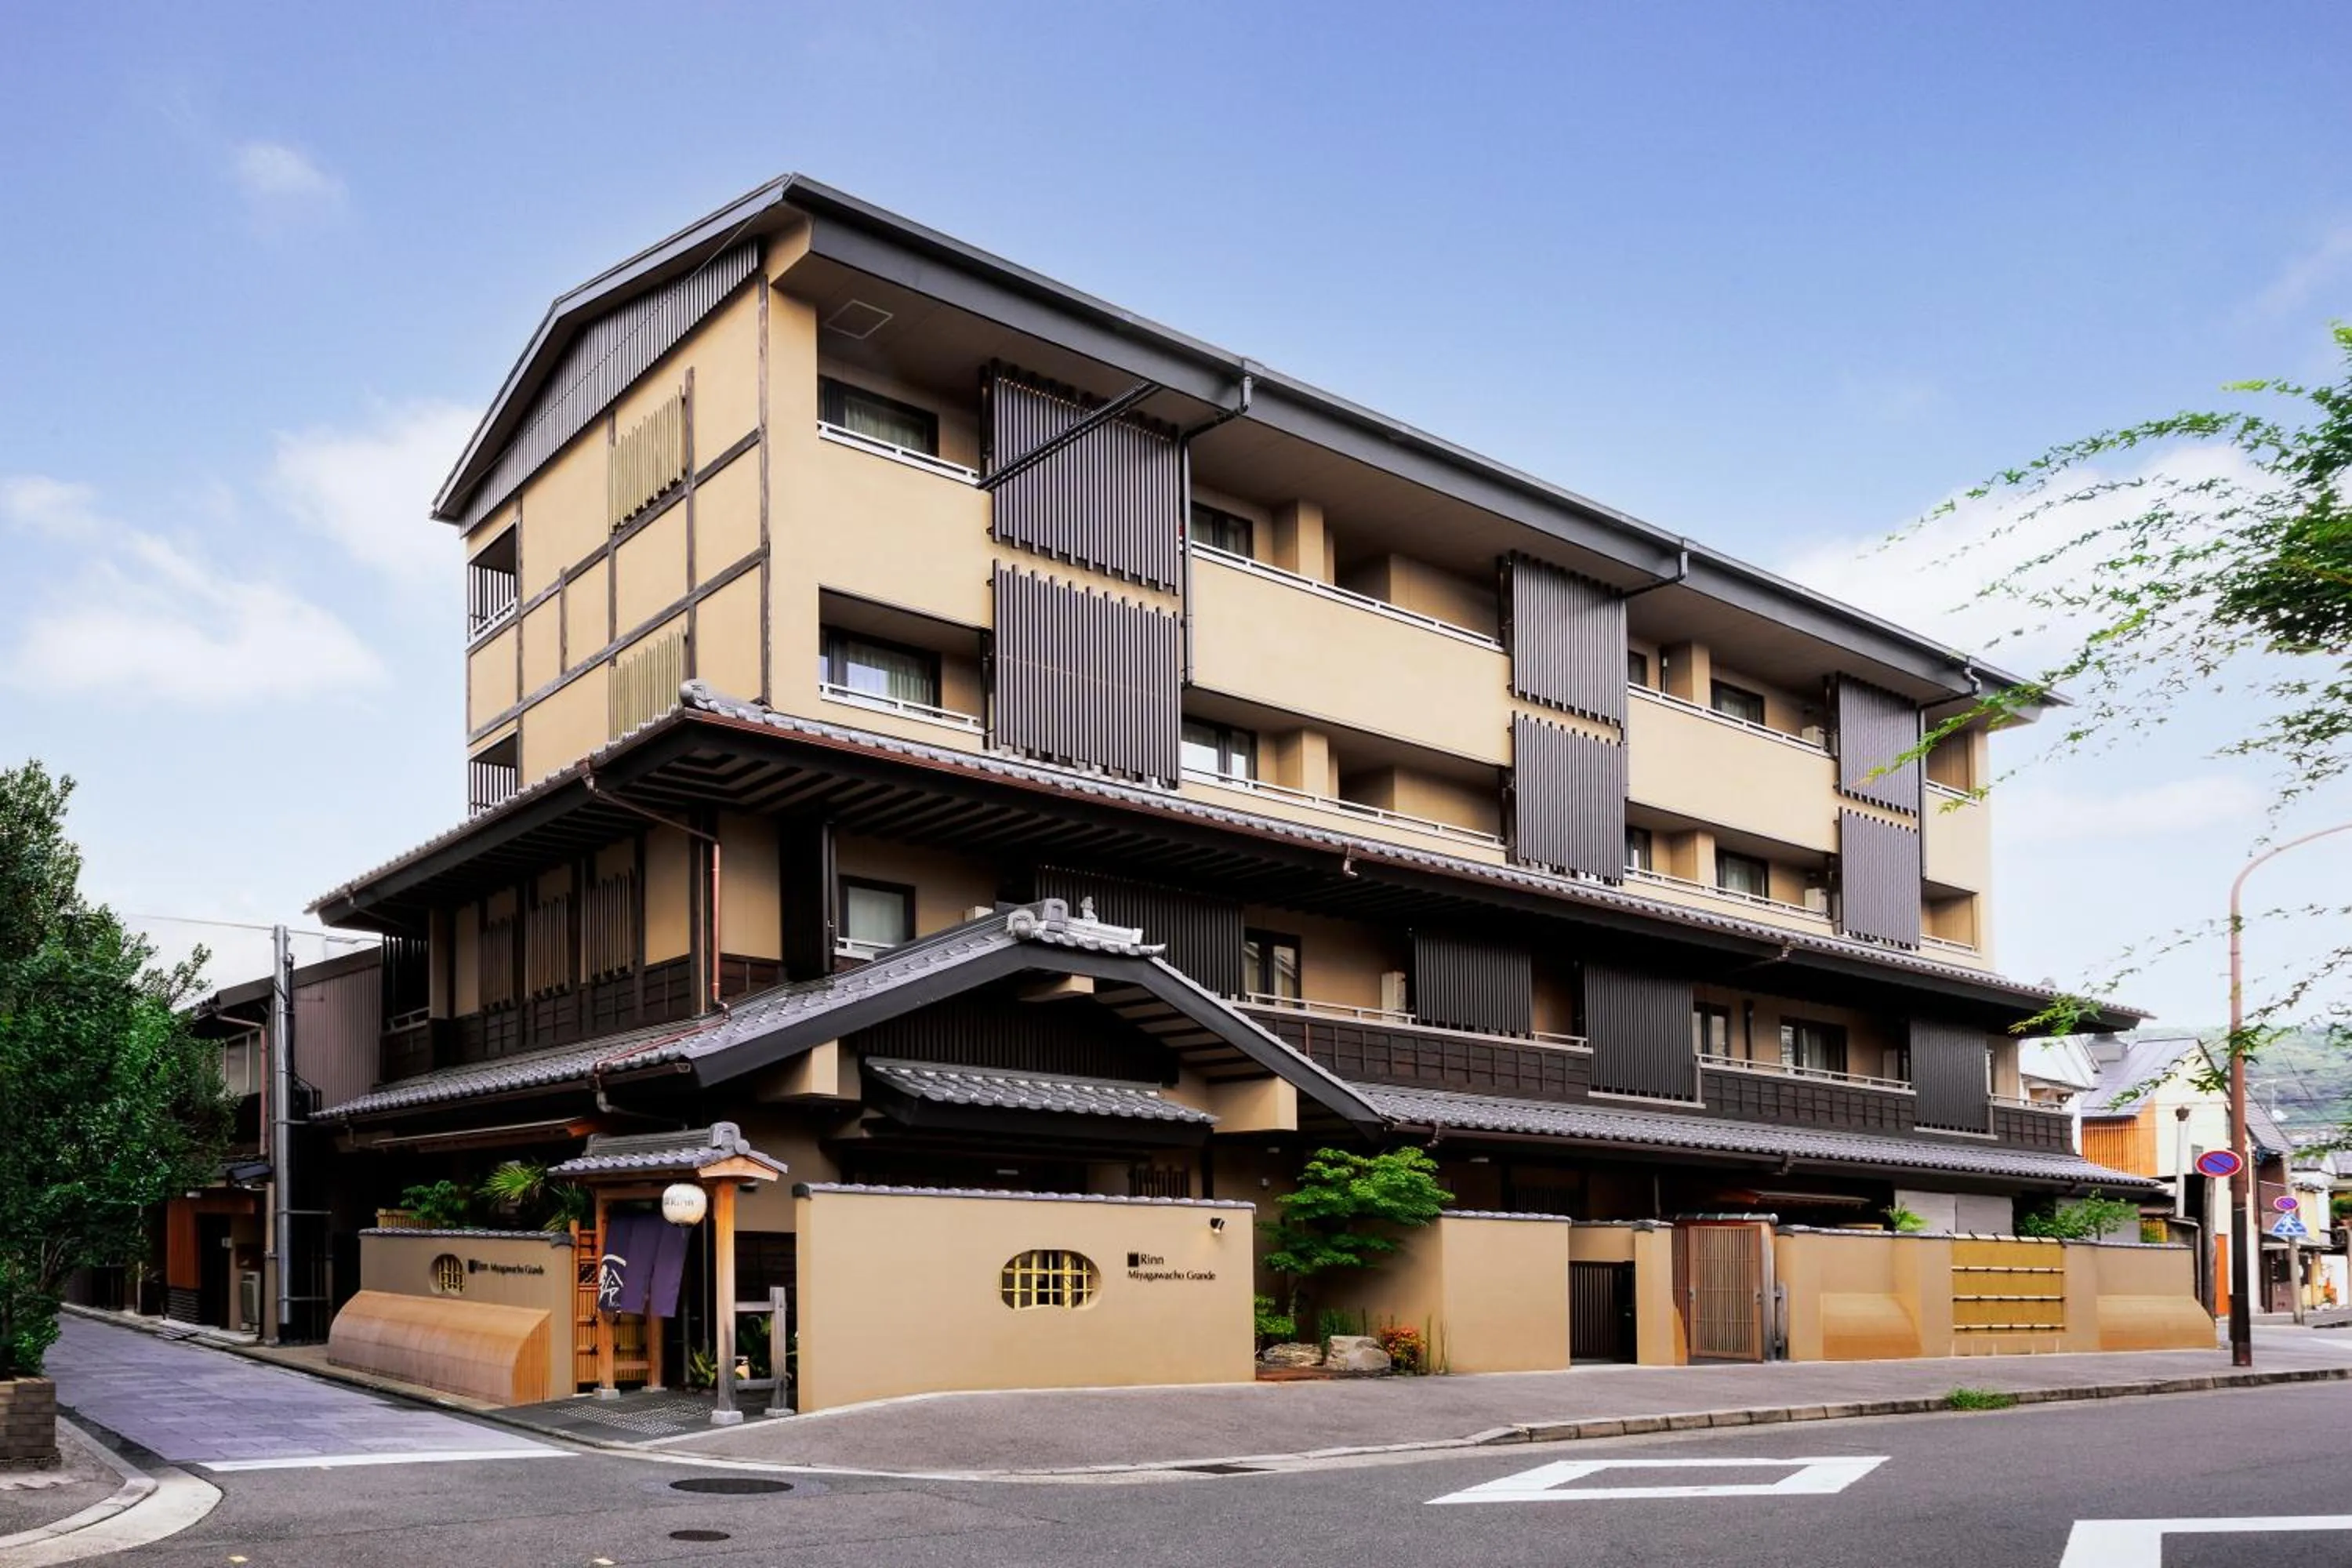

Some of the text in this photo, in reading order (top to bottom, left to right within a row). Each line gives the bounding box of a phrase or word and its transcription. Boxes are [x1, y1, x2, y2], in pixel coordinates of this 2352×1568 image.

[1141, 1254, 1164, 1265] Rinn
[1128, 1269, 1216, 1281] Miyagawacho Grande
